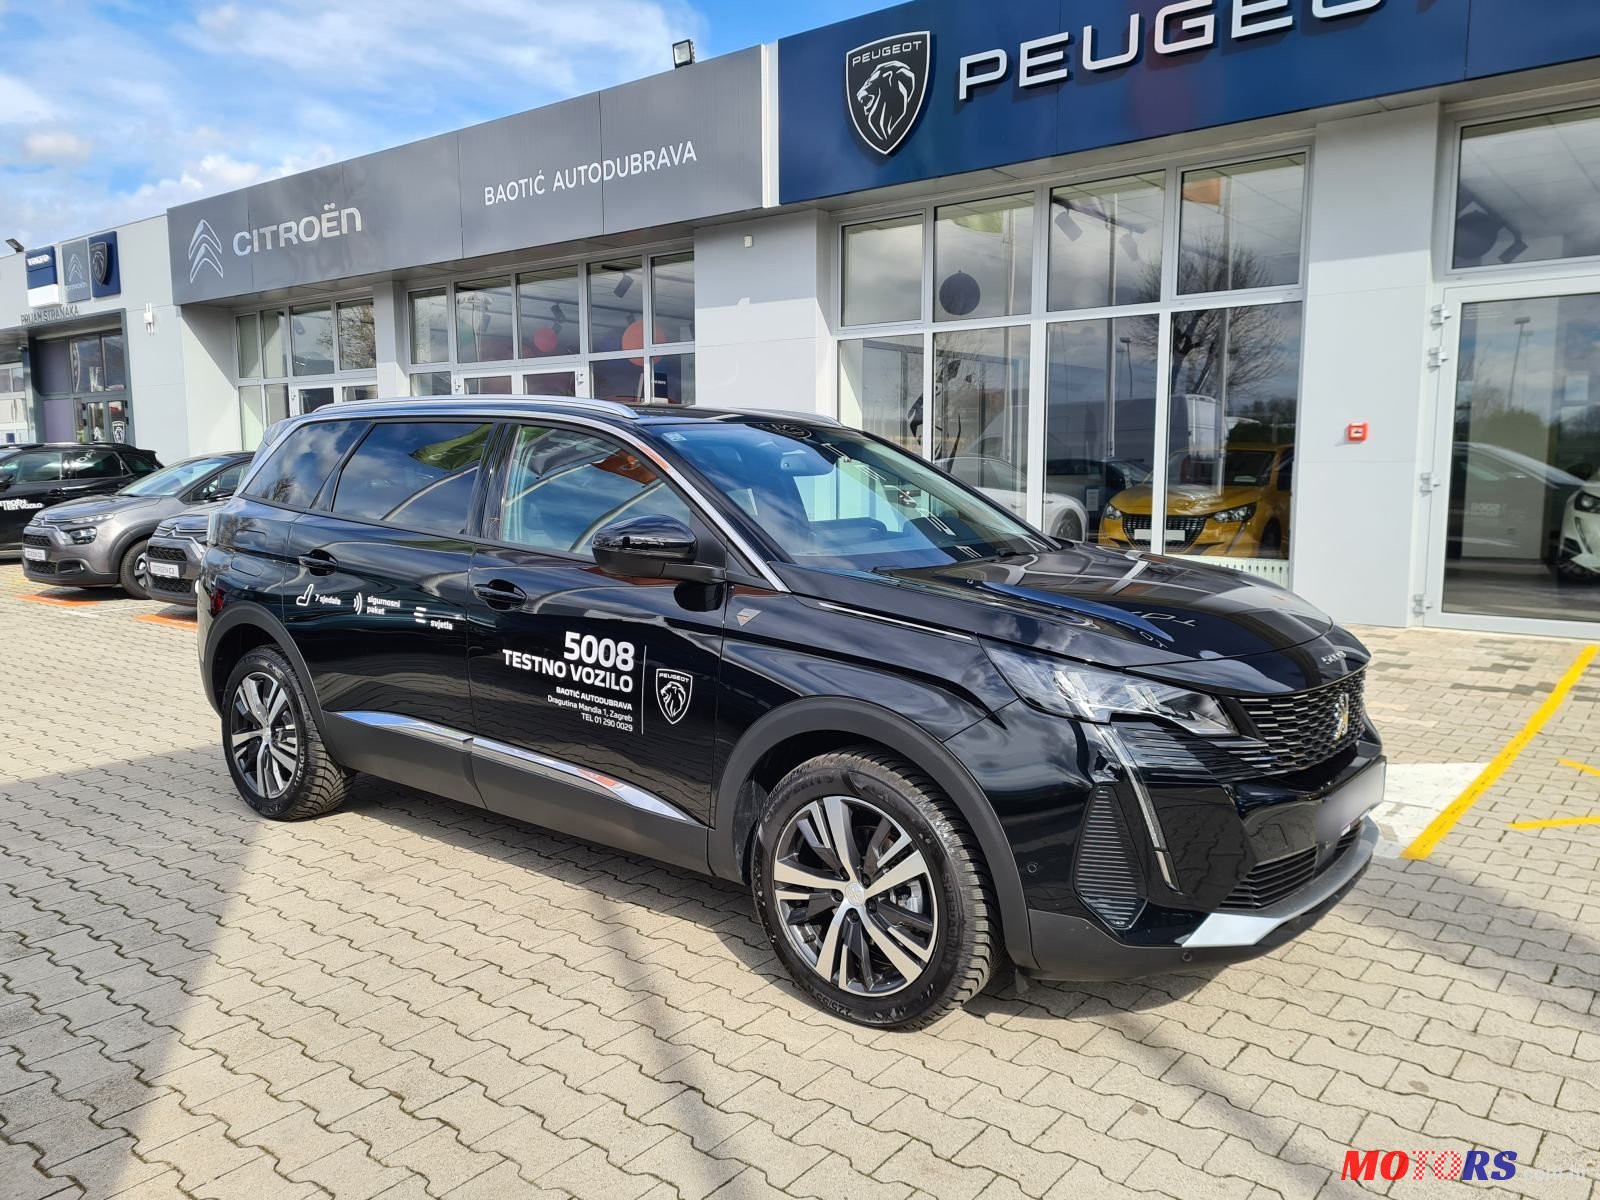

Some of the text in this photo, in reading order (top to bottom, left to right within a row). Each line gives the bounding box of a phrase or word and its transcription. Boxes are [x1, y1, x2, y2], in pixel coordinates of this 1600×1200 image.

[852, 40, 923, 67] PEUGEOT
[484, 140, 697, 206] BAOTIĆ AUTODUBRAVA
[232, 202, 362, 257] CITROËN
[315, 594, 341, 605] 7 sjedala
[366, 605, 385, 616] paket
[367, 595, 401, 608] sigurnosni
[430, 619, 453, 630] svjetla
[563, 631, 635, 672] 5008
[502, 649, 633, 693] TESTNO VOZILO
[659, 672, 690, 683] PEUGEOT
[547, 695, 578, 709] Dragutina
[609, 710, 633, 722] Zagreb
[555, 686, 632, 711] BAOTIĆ AUTODUBRAVA
[581, 712, 633, 732] TEL 01 290 0029
